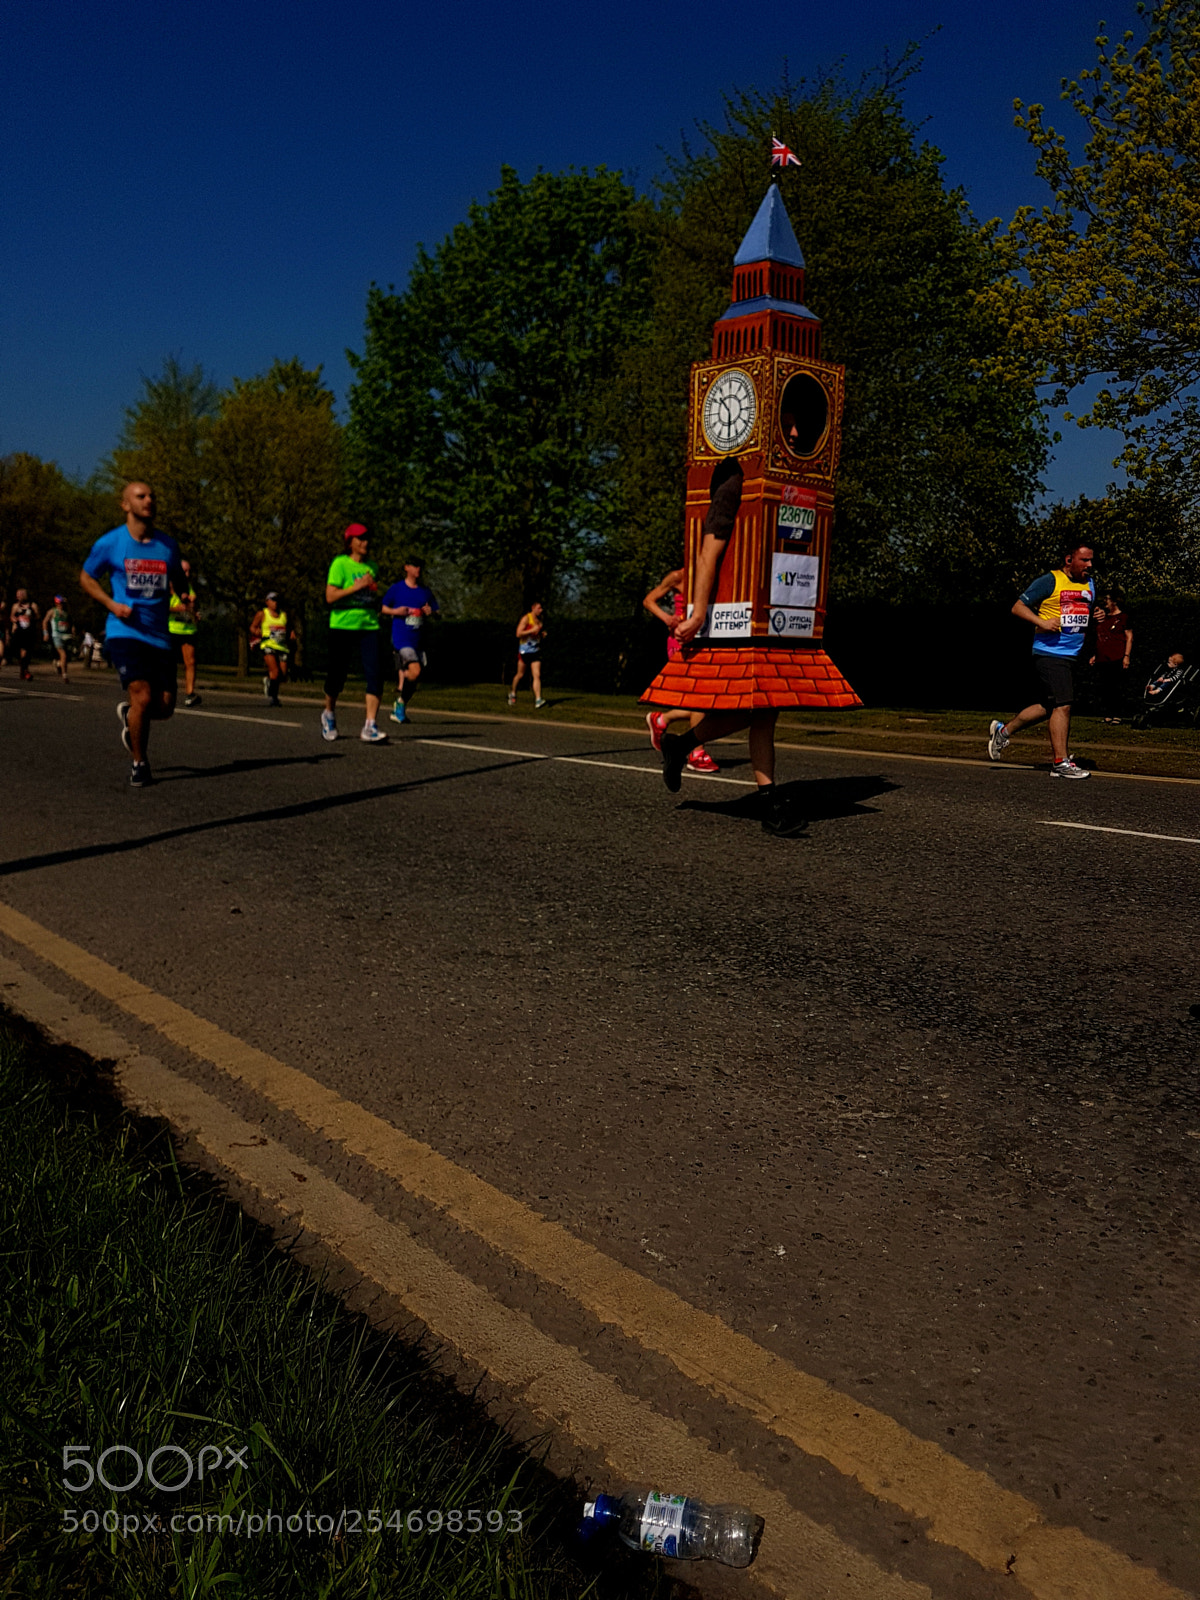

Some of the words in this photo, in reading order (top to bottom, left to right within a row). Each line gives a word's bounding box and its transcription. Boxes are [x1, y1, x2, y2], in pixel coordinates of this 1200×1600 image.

[780, 505, 815, 525] 23670
[785, 572, 797, 586] LY
[714, 610, 749, 620] OFFICIAL
[1062, 615, 1088, 625] 13495
[714, 621, 748, 630] ATTEMPT
